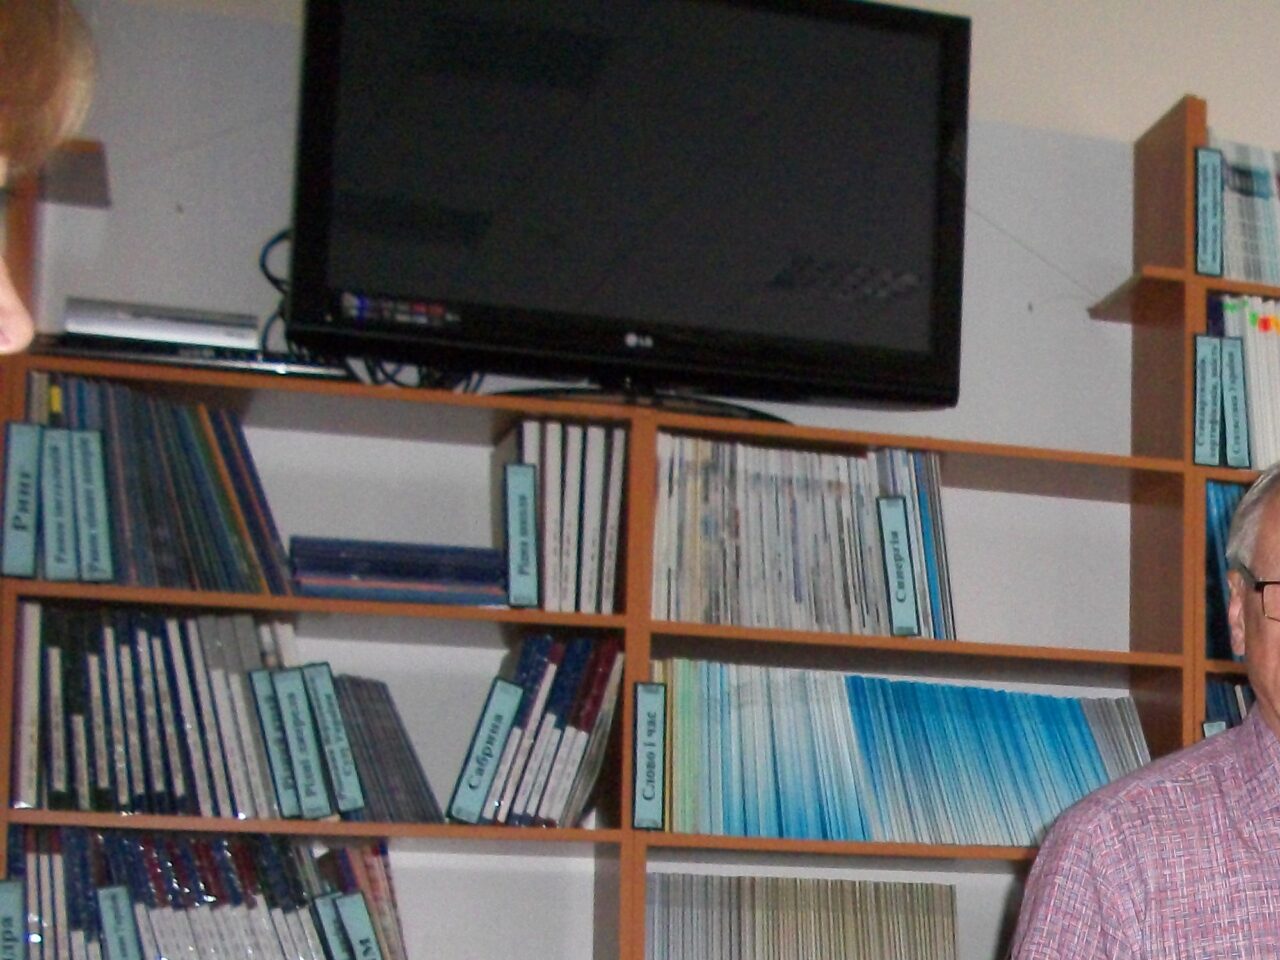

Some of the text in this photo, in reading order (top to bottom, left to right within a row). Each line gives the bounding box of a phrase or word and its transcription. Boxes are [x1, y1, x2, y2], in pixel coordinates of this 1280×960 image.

[646, 711, 656, 738] час
[466, 712, 504, 790] Сабрина
[642, 751, 656, 801] Слово
